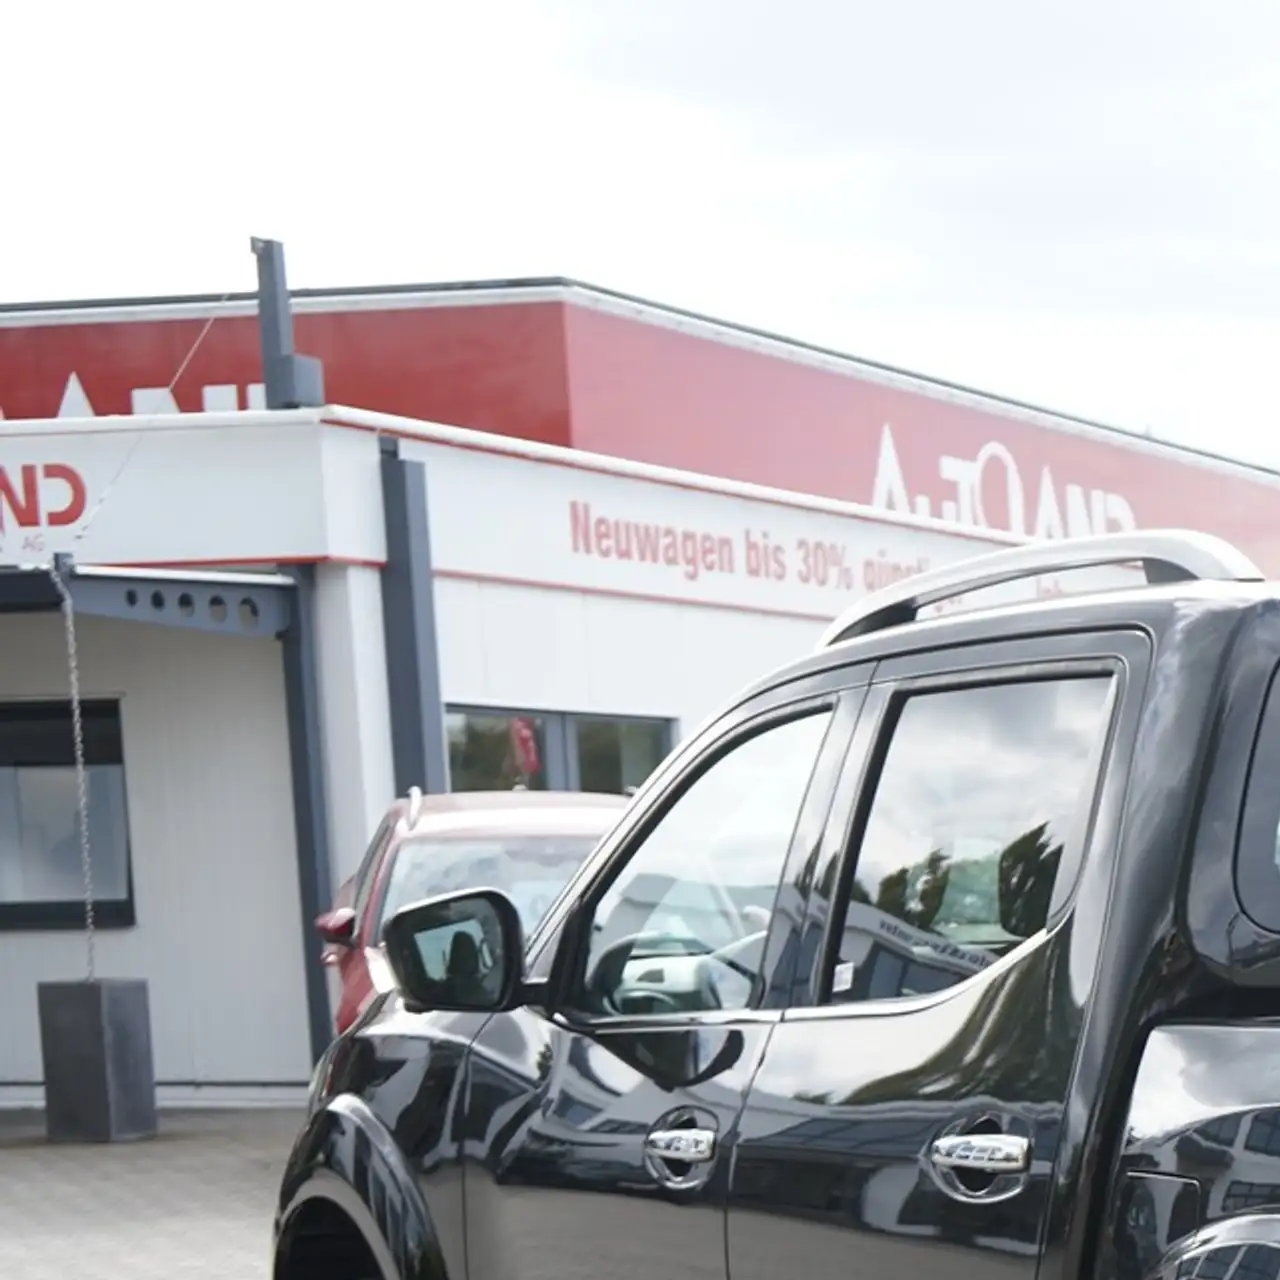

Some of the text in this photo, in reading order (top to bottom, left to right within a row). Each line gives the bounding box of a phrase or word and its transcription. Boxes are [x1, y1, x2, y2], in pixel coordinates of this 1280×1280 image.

[0, 463, 87, 532] ND
[568, 500, 736, 581] Neuwagen
[744, 527, 787, 581] bis
[797, 537, 854, 591] 30%
